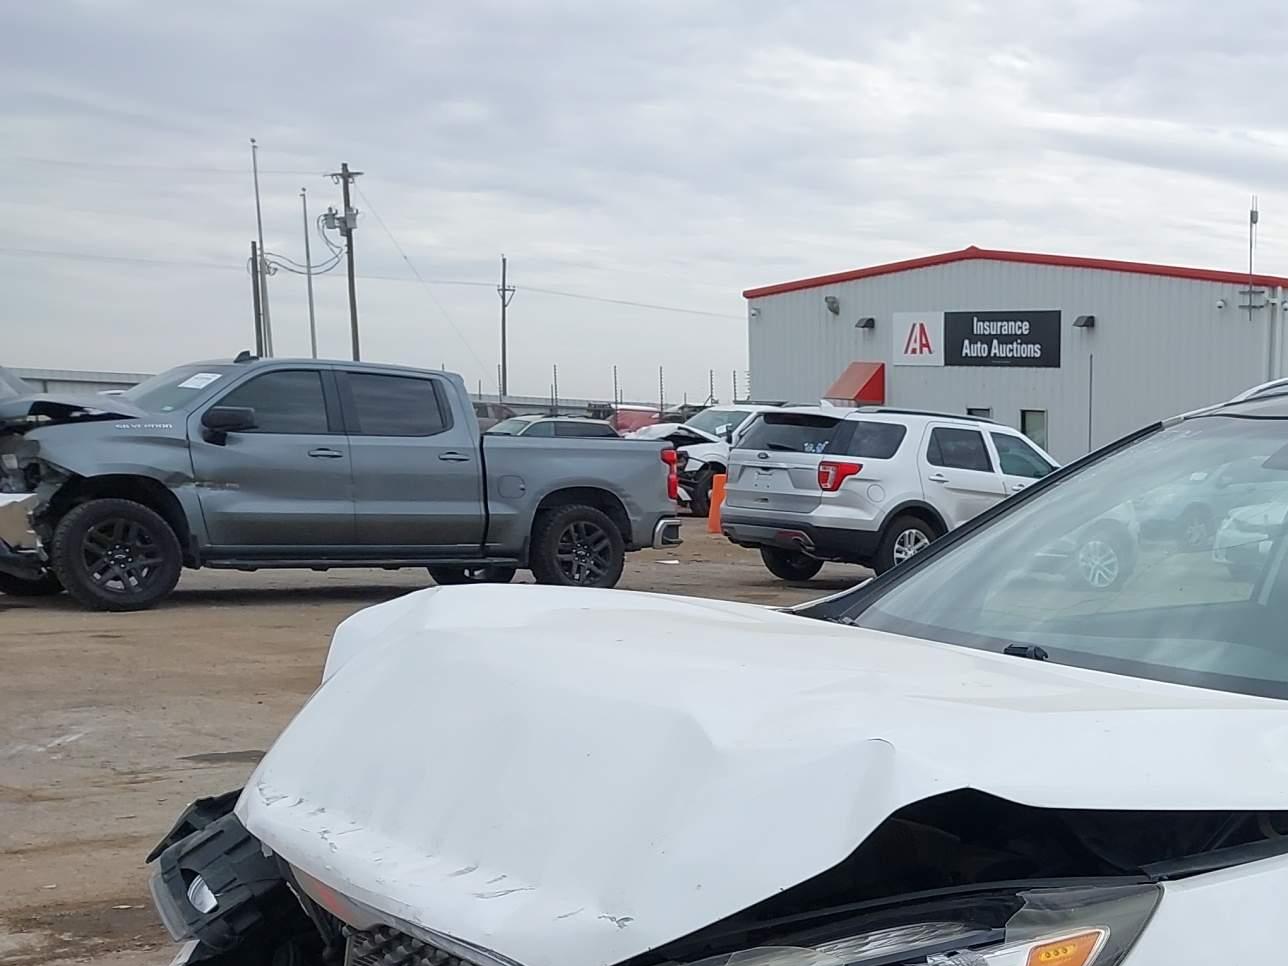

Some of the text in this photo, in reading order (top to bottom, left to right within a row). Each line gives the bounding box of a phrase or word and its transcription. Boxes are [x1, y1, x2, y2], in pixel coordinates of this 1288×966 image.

[973, 316, 1030, 335] Insurance
[961, 338, 1042, 358] Auto Auctions
